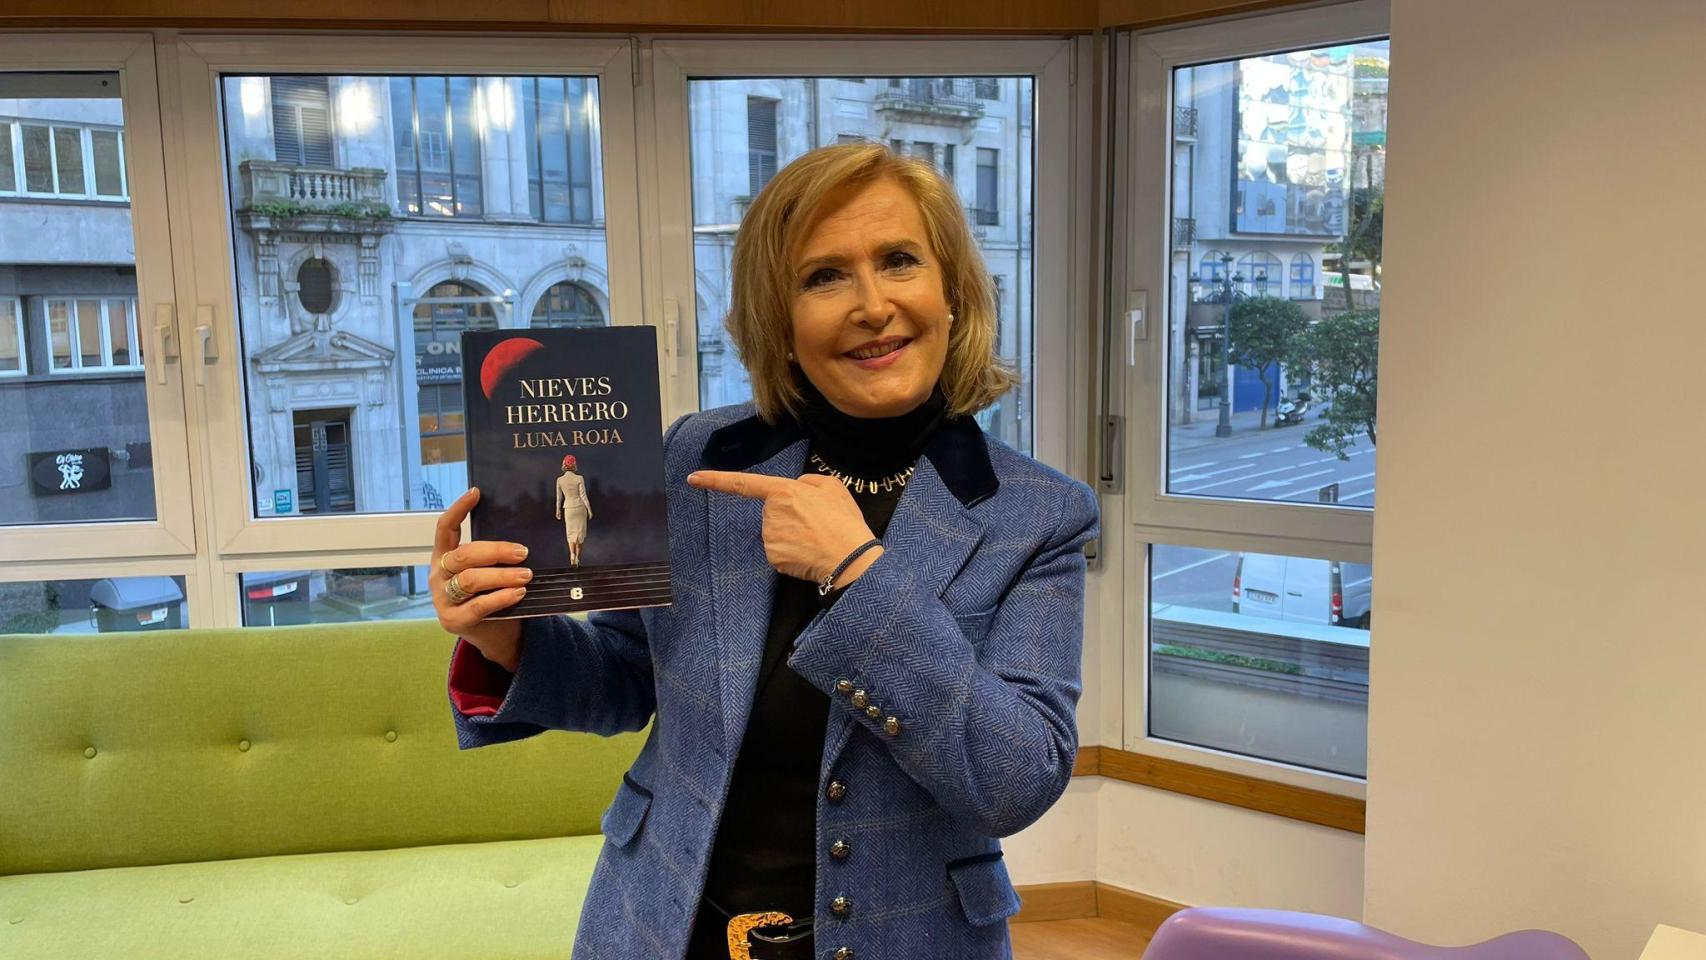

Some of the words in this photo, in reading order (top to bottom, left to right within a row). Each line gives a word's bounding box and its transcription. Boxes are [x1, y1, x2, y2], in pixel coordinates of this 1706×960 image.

[519, 377, 612, 399] NIEVES
[505, 400, 628, 425] HERRERO
[513, 431, 567, 449] LUNA
[571, 428, 624, 446] ROJA
